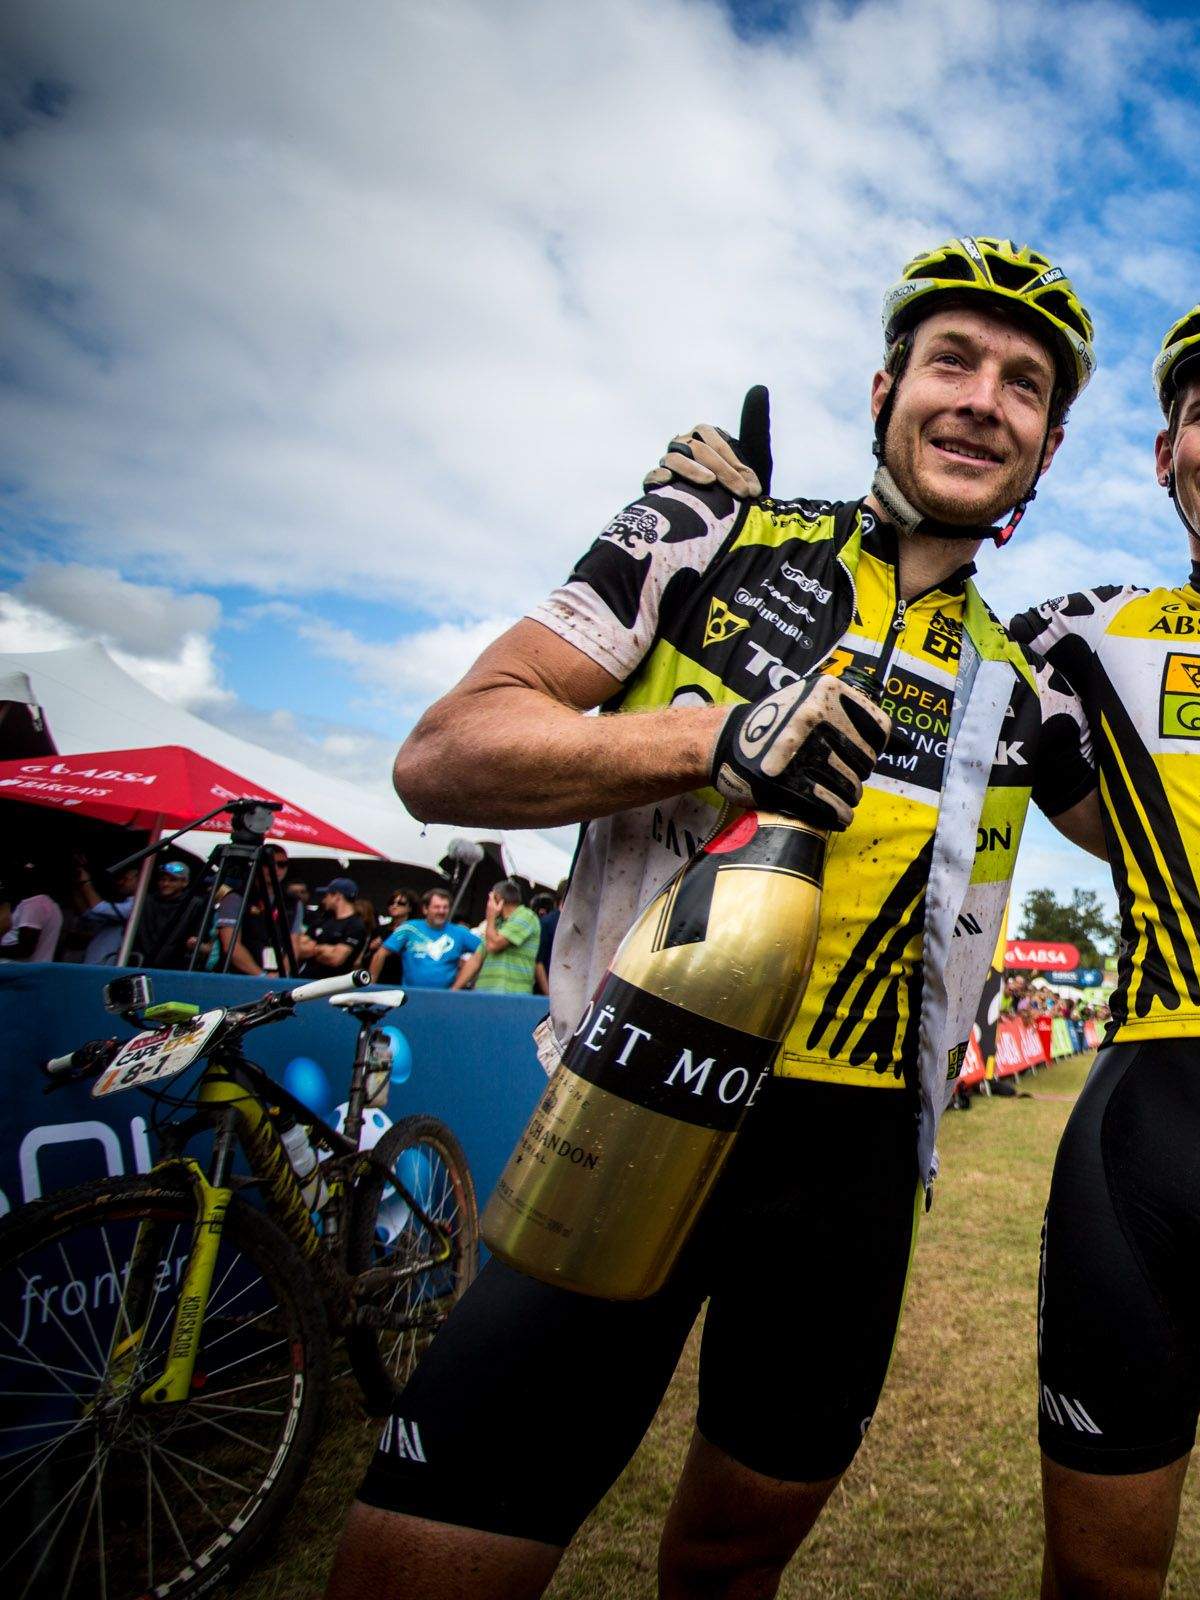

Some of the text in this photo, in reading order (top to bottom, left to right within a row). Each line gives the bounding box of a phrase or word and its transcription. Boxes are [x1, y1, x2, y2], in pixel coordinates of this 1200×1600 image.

[923, 627, 962, 663] EP
[872, 670, 950, 716] OPEA
[880, 697, 950, 738] RGON
[17, 780, 113, 797] BARCLAYS
[69, 768, 158, 786] ABSA
[116, 1043, 164, 1066] CAPE
[120, 1054, 171, 1085] 8-1
[663, 1047, 770, 1107] MOË
